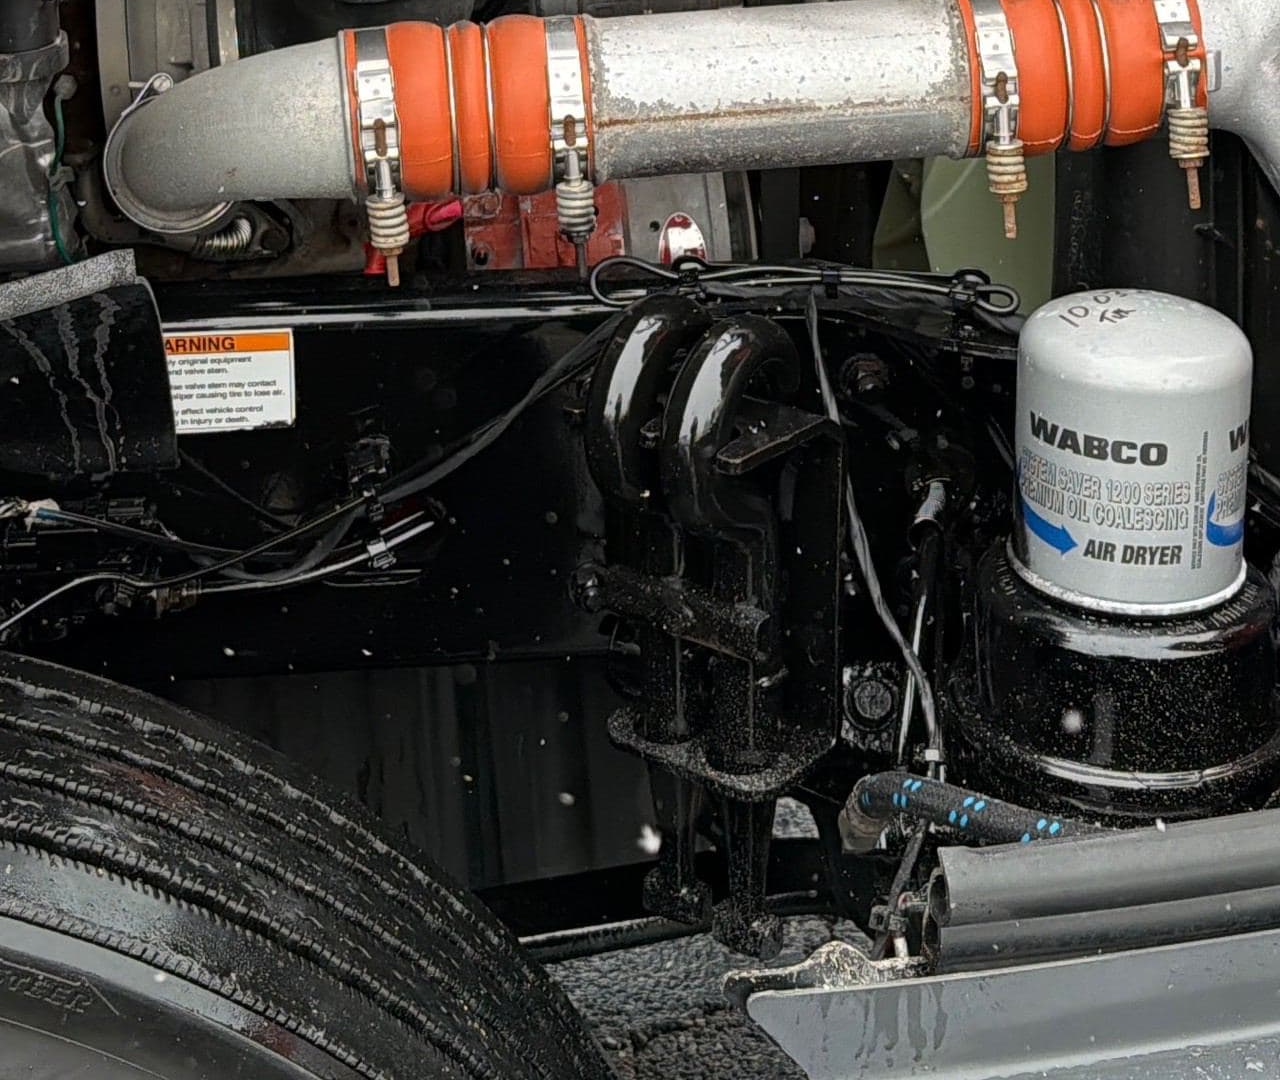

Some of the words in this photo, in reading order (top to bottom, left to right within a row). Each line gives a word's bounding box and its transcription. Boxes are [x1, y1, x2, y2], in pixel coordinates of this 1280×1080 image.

[165, 336, 235, 352] ARNING
[178, 357, 209, 367] original
[210, 356, 252, 365] equipment
[185, 382, 206, 390] valve
[207, 381, 228, 389] stem
[229, 381, 245, 390] may
[247, 379, 277, 388] contact
[196, 392, 228, 400] causing
[229, 390, 242, 398] tire
[206, 406, 234, 414] vehicle
[235, 405, 264, 413] control
[190, 417, 214, 426] injury
[1030, 410, 1169, 466] WABCO
[1058, 467, 1102, 501] SAVER
[1105, 478, 1142, 506] 1200
[1144, 481, 1192, 507] SERIES
[1020, 473, 1065, 516] PREMIUM
[1067, 495, 1090, 524] OIL
[1093, 502, 1189, 531] COALESCING
[1083, 538, 1117, 562] AIR
[1121, 544, 1183, 566] DRYER
